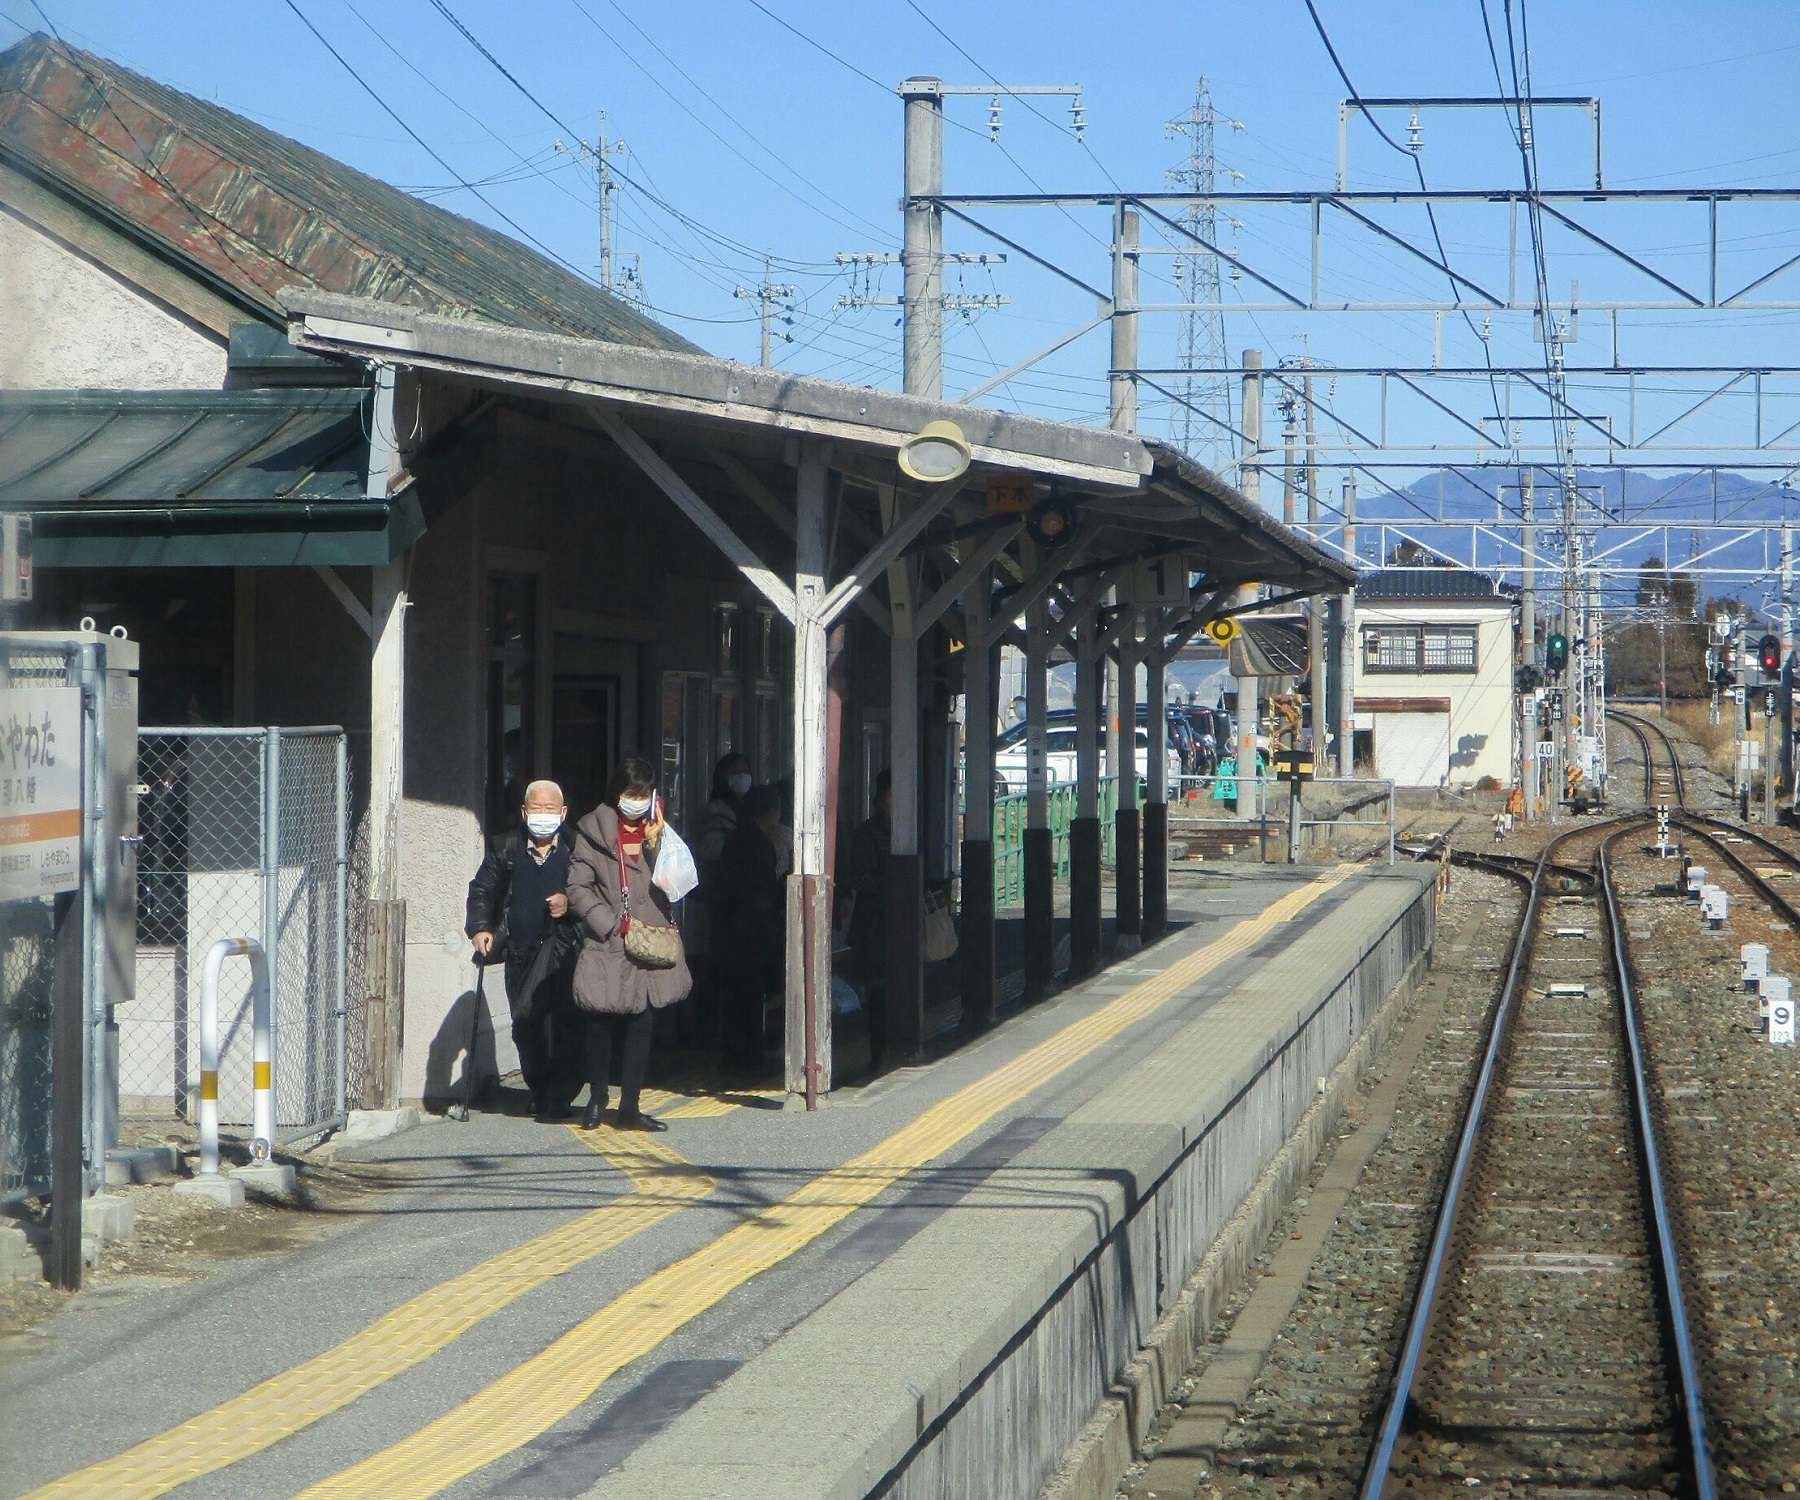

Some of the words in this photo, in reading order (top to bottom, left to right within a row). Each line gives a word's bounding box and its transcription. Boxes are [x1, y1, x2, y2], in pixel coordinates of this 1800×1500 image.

[1148, 559, 1165, 595] 1
[1538, 743, 1553, 755] 40
[1774, 1007, 1790, 1025] 9
[1772, 1031, 1790, 1041] 123
